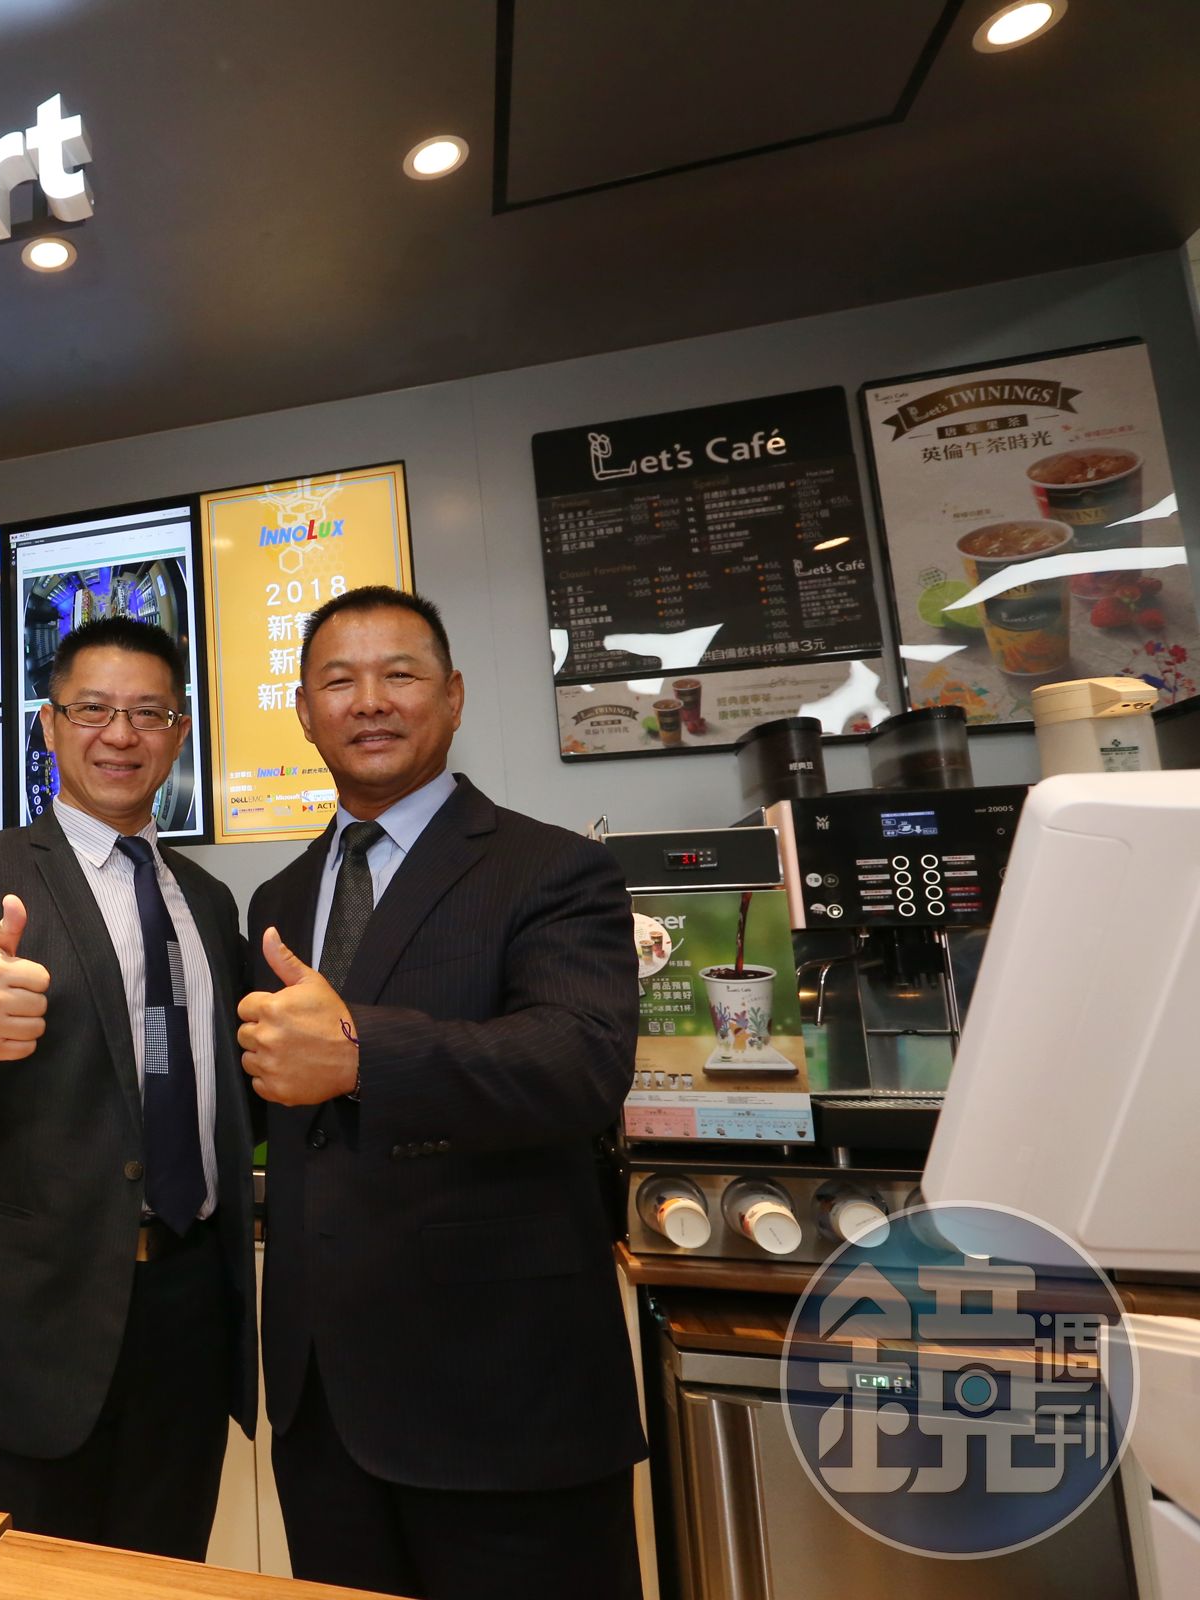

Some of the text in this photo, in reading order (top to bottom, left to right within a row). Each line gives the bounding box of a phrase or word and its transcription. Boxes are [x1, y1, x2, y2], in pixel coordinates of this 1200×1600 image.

[945, 384, 1054, 408] TWININGS
[588, 428, 786, 480] Let's Café
[921, 430, 1054, 463] 英倫午茶時光
[793, 558, 865, 577] Let's Café
[266, 575, 348, 607] 2018
